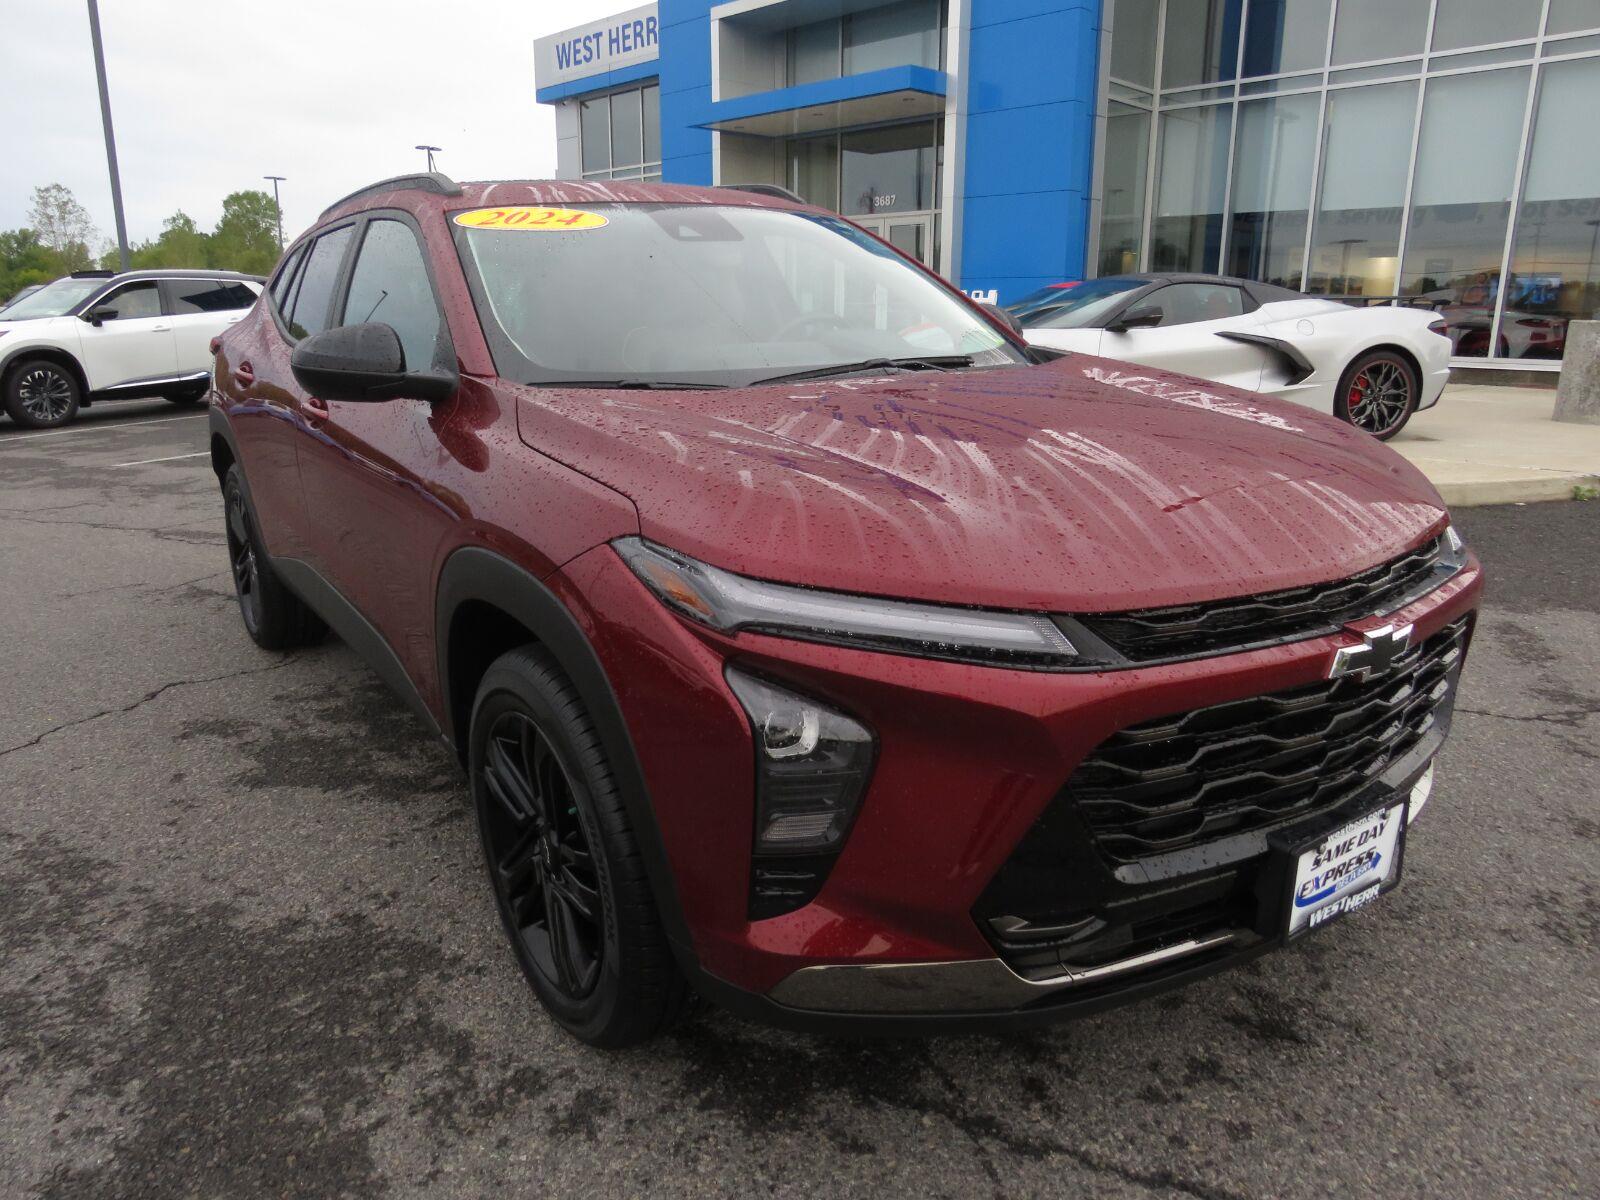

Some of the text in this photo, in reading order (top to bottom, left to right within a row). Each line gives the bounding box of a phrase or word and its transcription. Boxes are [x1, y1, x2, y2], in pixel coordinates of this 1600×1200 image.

[555, 16, 658, 70] WEST HERR
[476, 211, 585, 226] 2024
[873, 194, 896, 207] 3687
[1310, 819, 1390, 871] SAME DAY
[1299, 846, 1377, 898] EXPRESS
